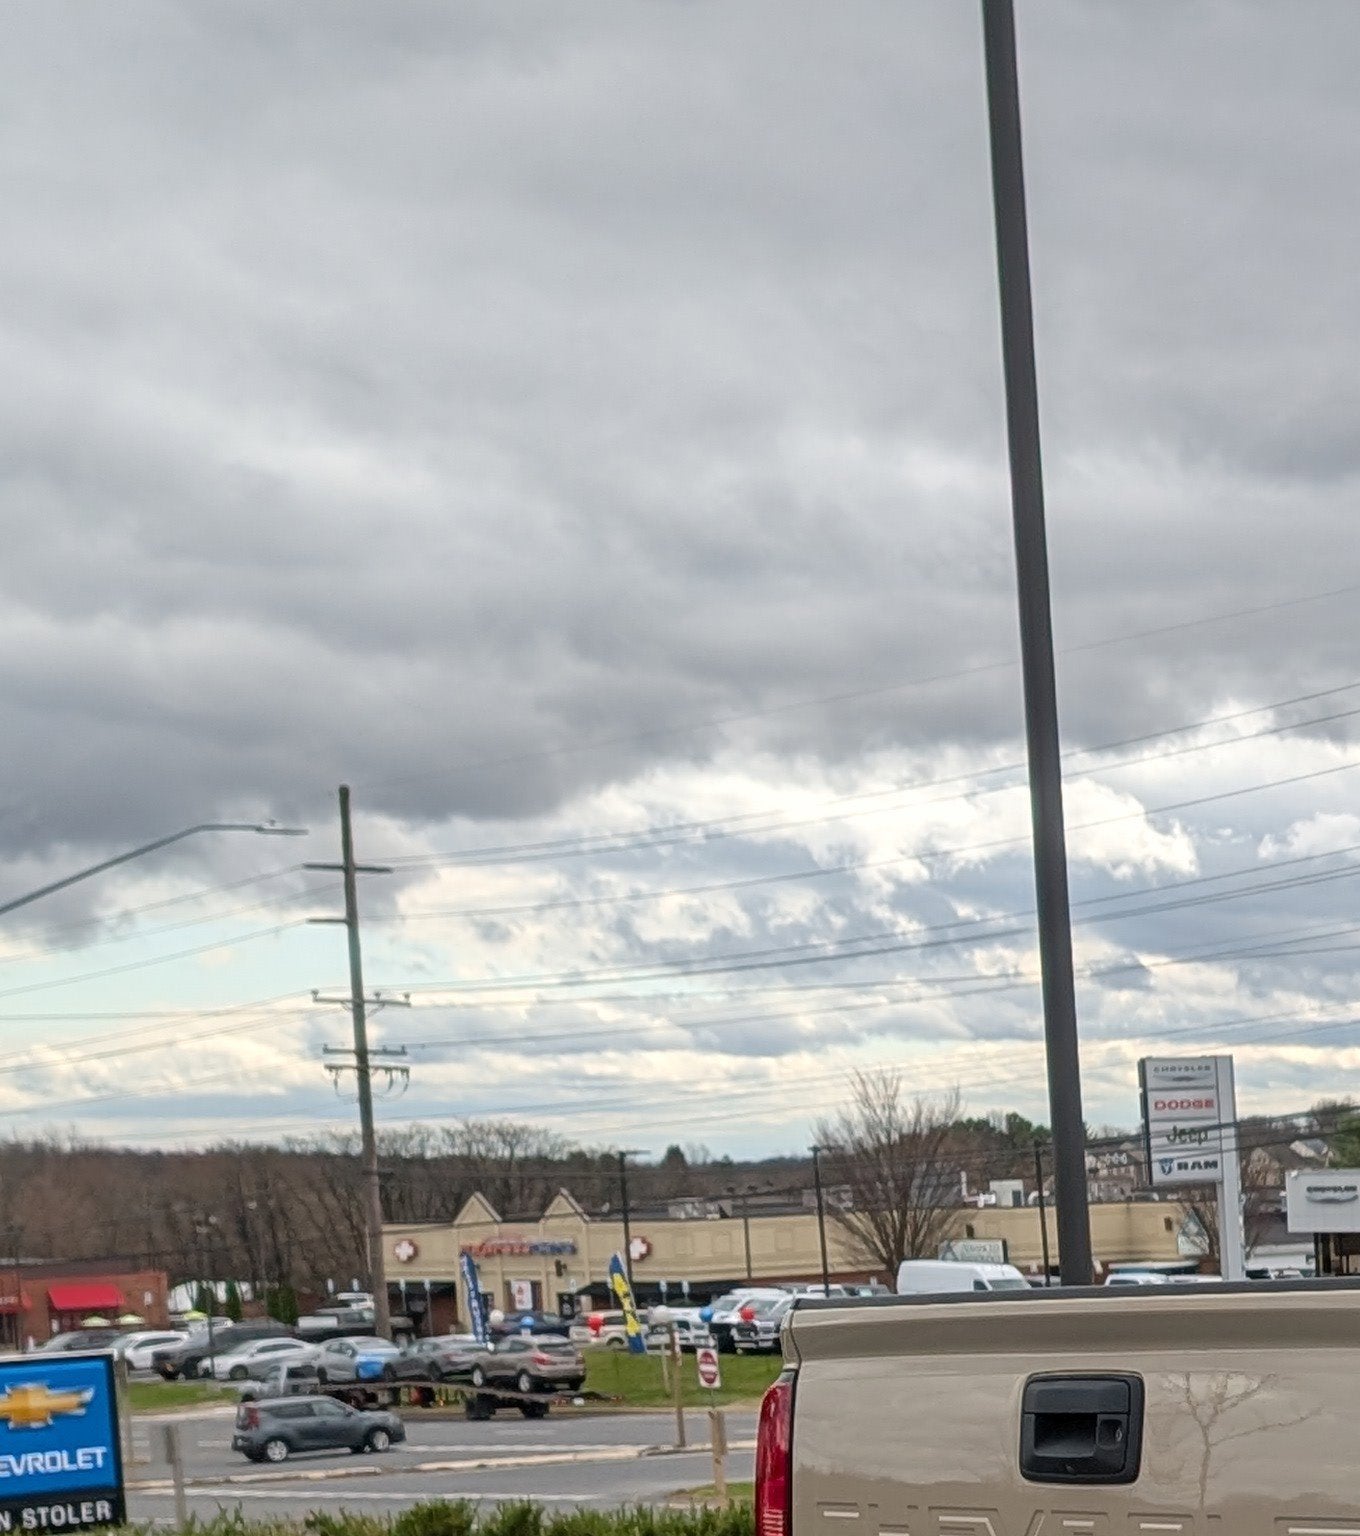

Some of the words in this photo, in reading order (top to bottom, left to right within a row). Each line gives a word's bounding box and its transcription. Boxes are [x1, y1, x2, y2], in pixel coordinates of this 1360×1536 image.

[1154, 1099, 1215, 1111] DODGE
[1166, 1125, 1208, 1146] Jeep
[1177, 1160, 1218, 1171] RAM
[22, 1500, 112, 1529] STOLER
